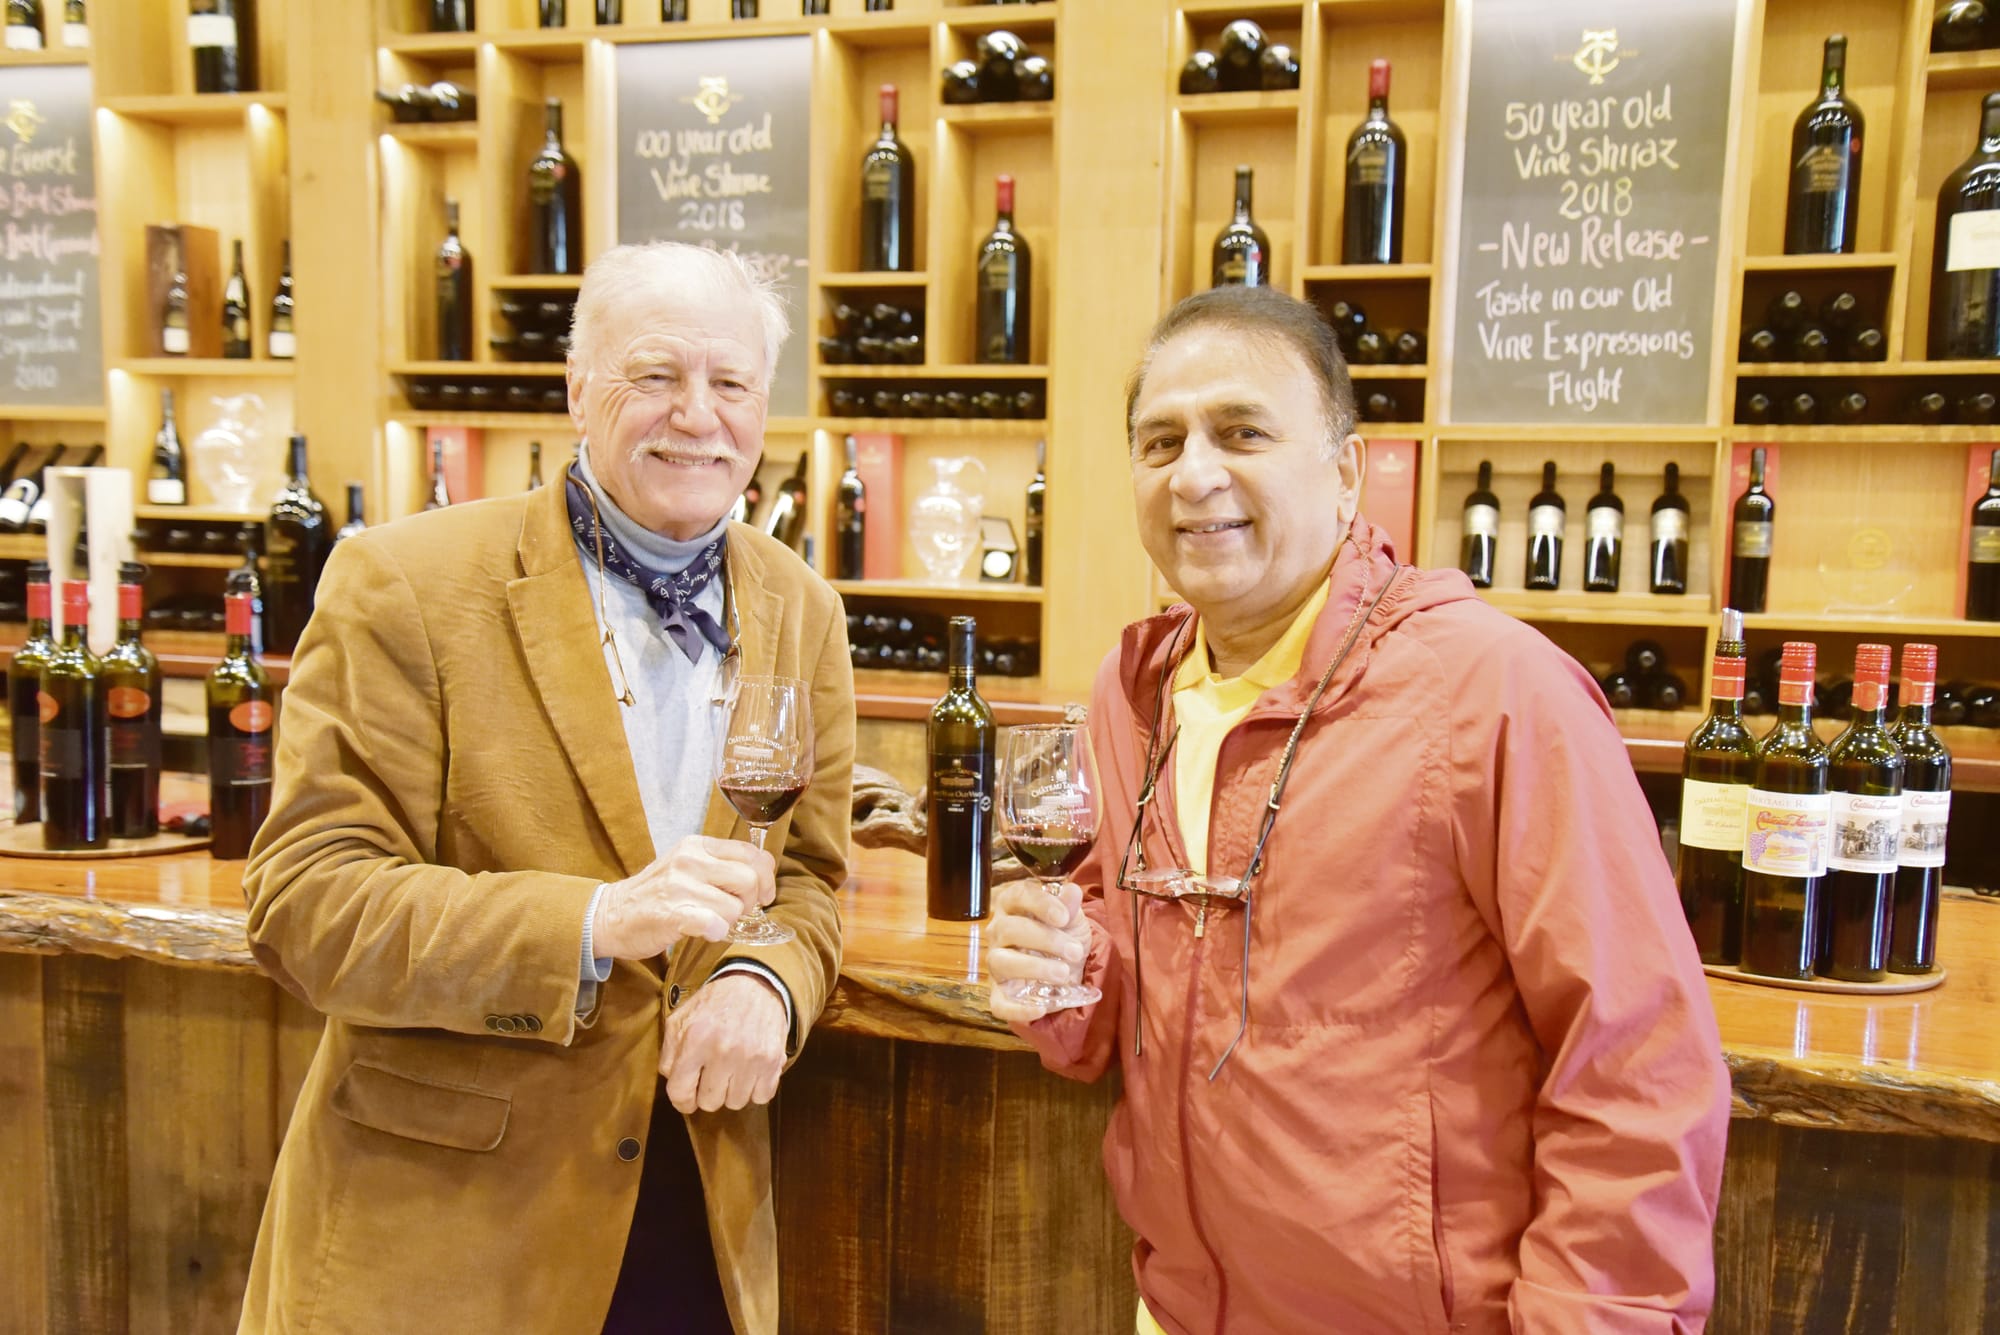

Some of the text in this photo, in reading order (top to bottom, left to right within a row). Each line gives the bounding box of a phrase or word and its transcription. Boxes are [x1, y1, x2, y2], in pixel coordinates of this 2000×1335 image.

[1504, 83, 1672, 153] 50 year Old
[1514, 134, 1680, 180] Vine Shiraz
[676, 200, 747, 231] 2018
[1558, 176, 1633, 220] 2018
[1475, 273, 1673, 320] Taste in our Old
[1478, 319, 1695, 371] Vine Expressions
[1548, 367, 1624, 413] Flight
